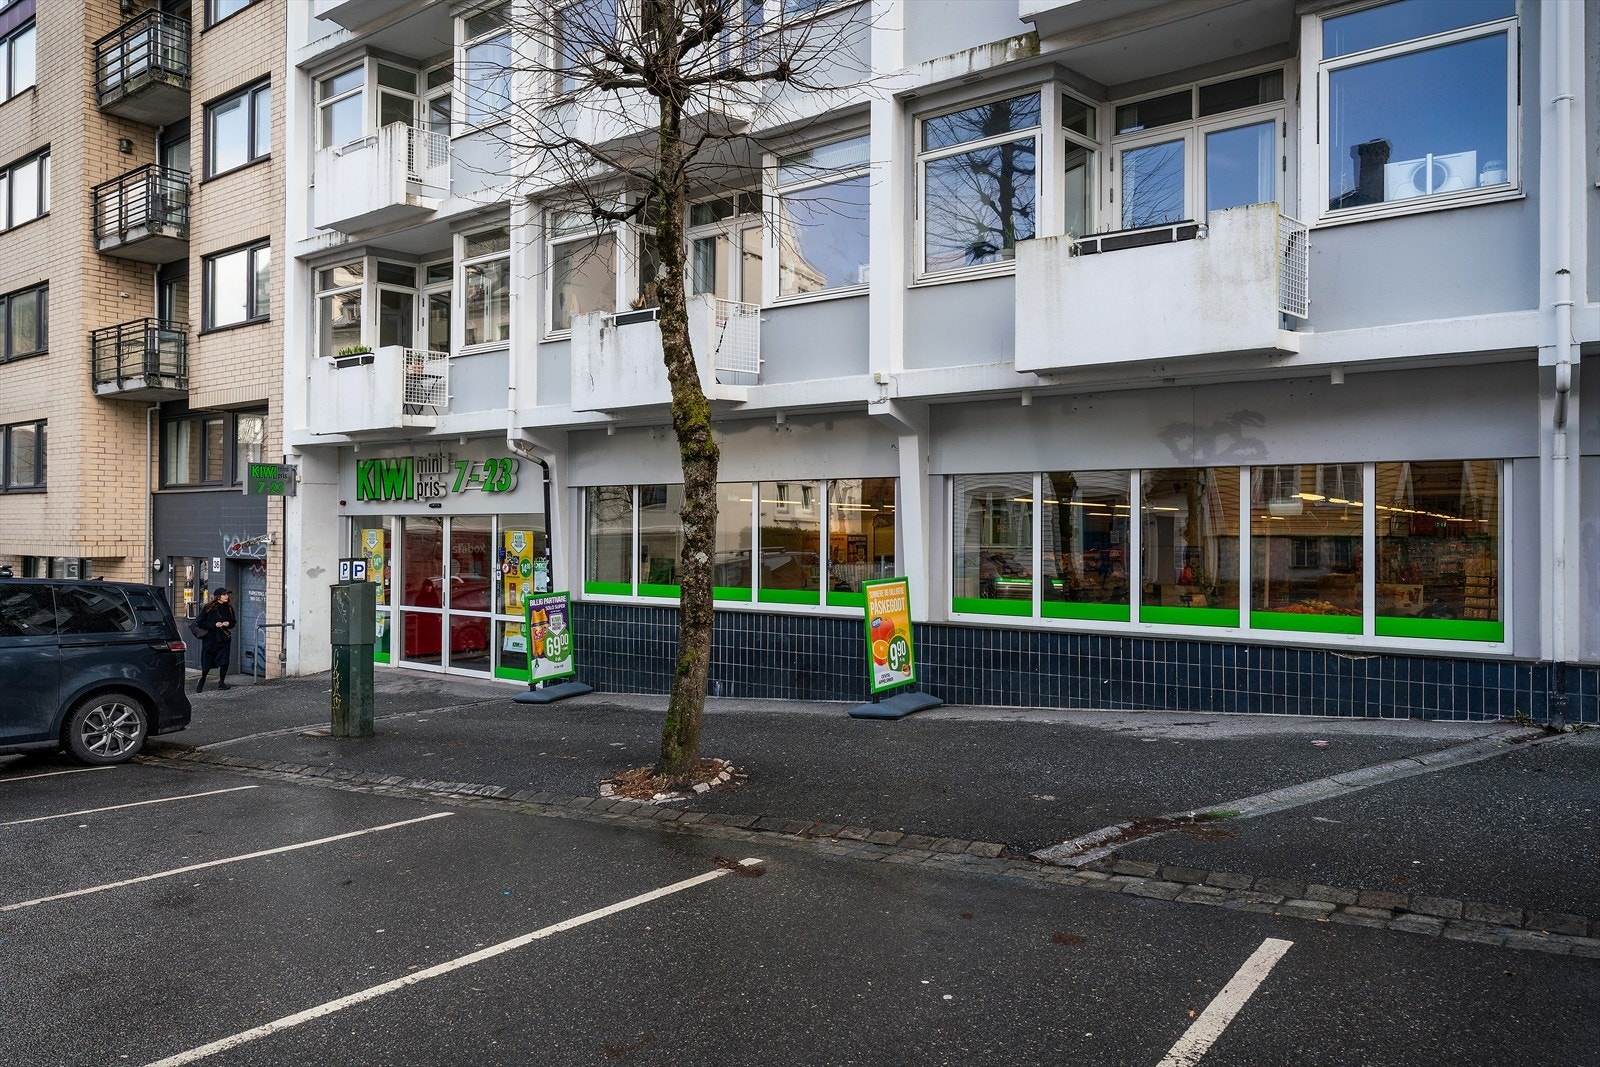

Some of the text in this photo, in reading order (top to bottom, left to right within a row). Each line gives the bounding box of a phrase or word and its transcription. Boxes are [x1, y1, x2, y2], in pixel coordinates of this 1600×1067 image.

[417, 453, 442, 473] mini
[251, 465, 277, 478] KIWI
[357, 456, 513, 501] KIWI 7-23
[256, 481, 285, 493] 7-23
[417, 476, 440, 502] pris
[342, 563, 348, 576] P
[354, 564, 364, 577] P
[870, 597, 905, 615] PÅSKEGODT
